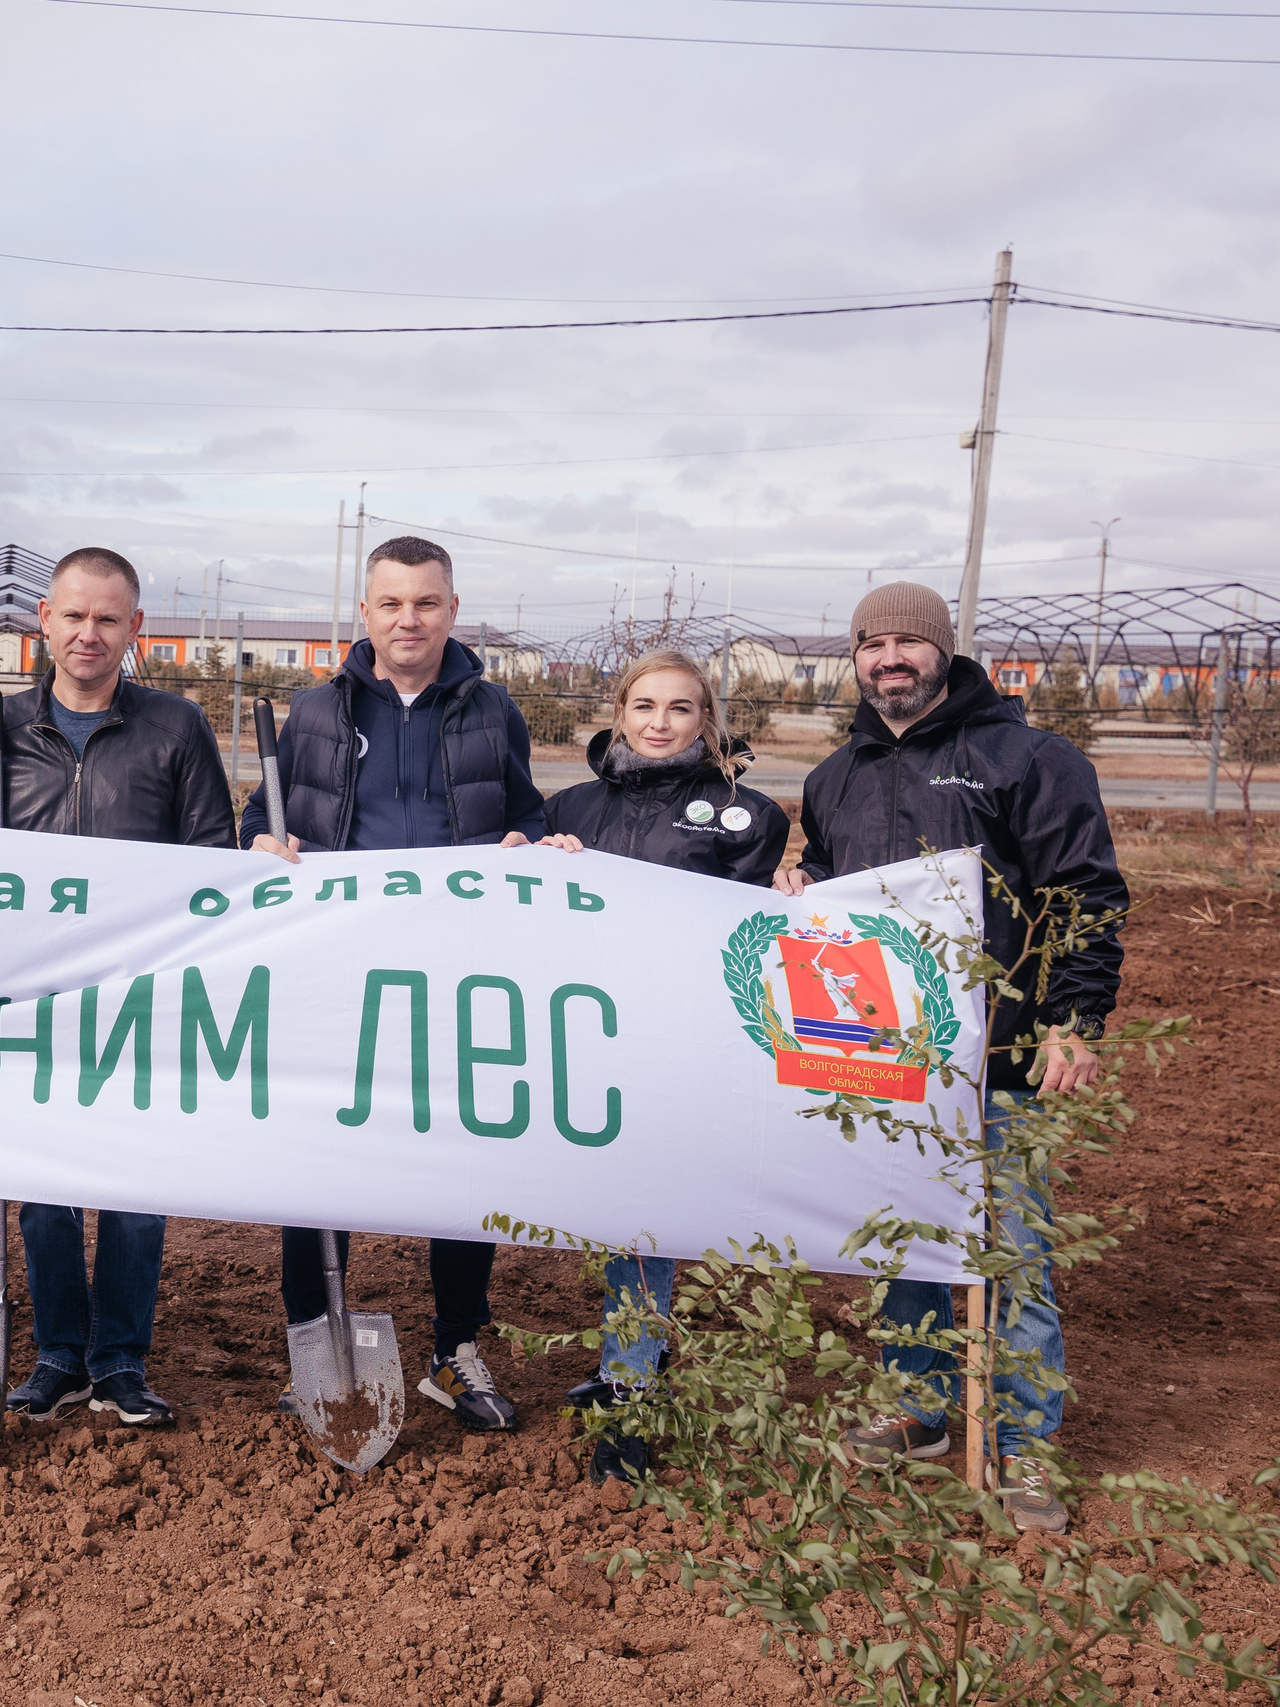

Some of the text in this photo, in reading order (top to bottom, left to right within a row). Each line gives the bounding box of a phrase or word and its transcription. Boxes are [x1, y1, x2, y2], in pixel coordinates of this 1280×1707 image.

[189, 870, 606, 917] область
[336, 968, 622, 1147] лес
[799, 1058, 904, 1082] ВОЛГОГРАДСКАЯ
[827, 1076, 876, 1092] ОБЛАСТЬ
